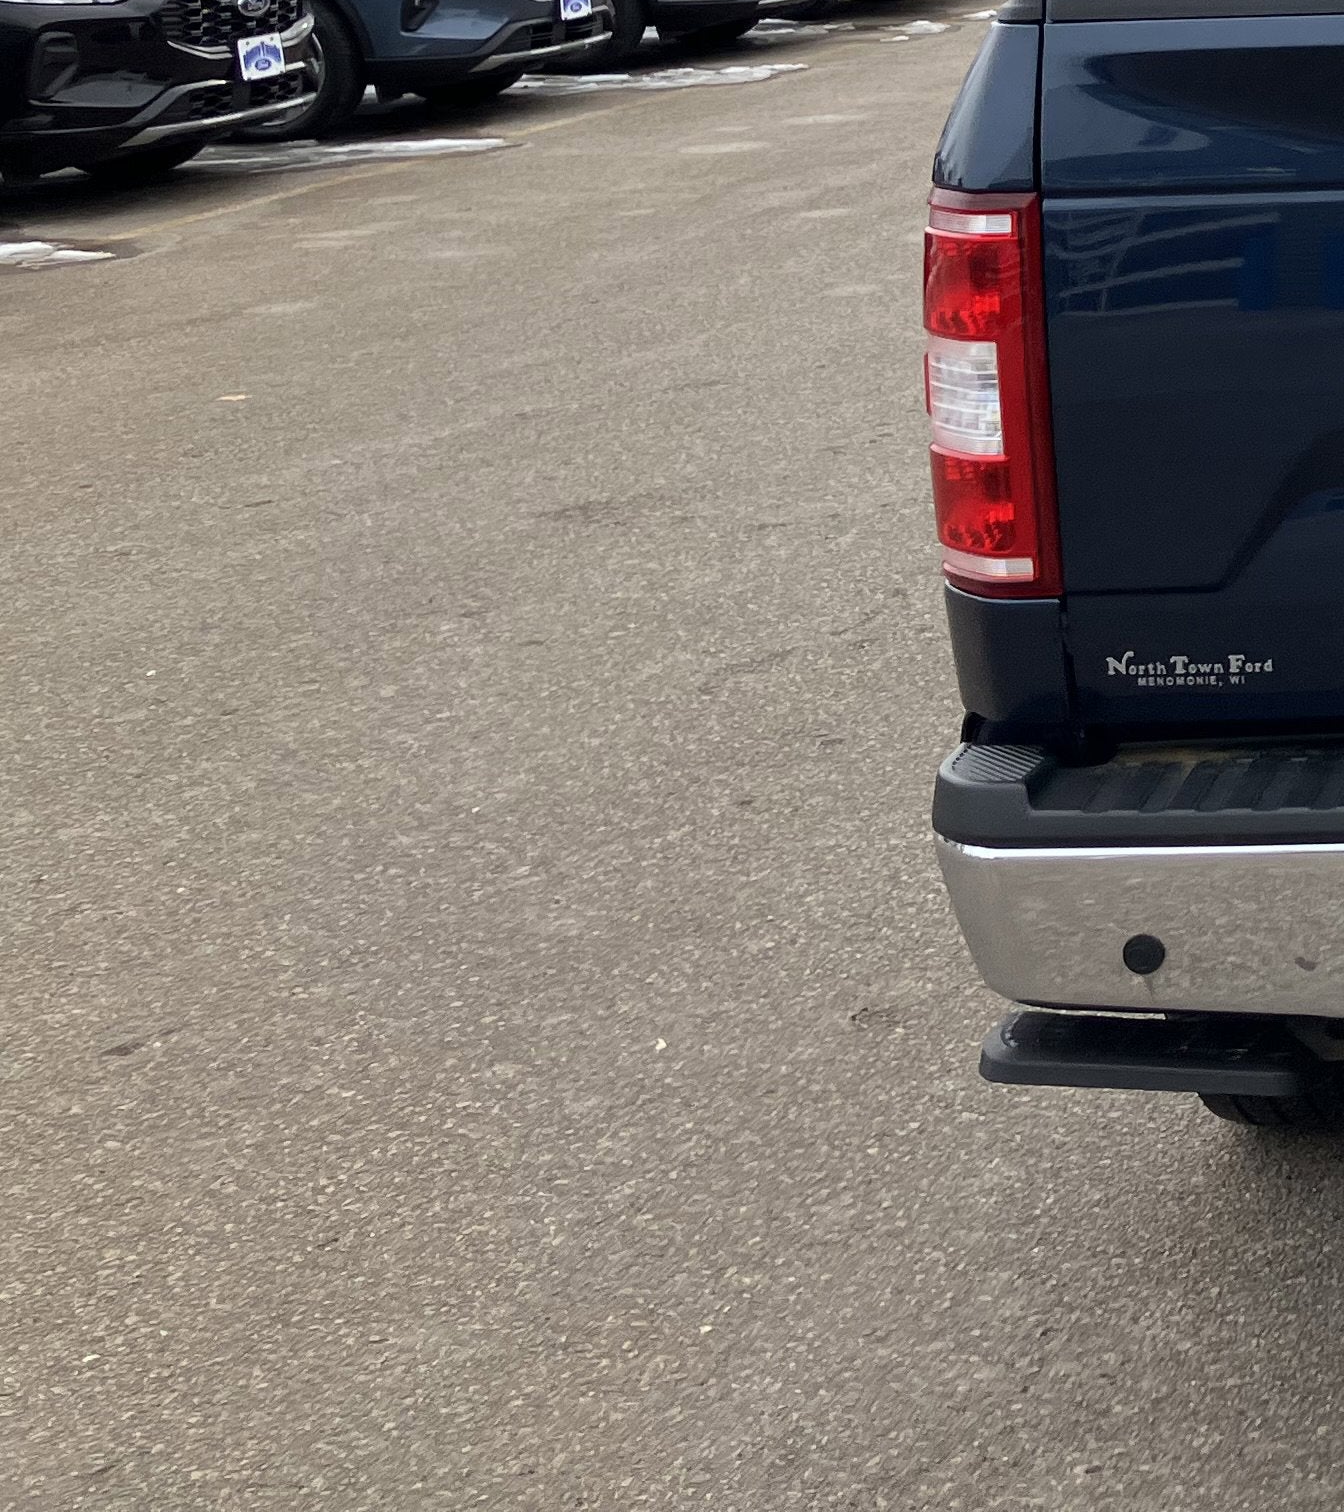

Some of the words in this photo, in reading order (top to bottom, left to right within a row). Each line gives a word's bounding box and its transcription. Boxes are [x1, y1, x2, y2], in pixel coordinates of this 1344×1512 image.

[1105, 650, 1167, 675] North
[1170, 654, 1225, 675] Town
[1228, 653, 1273, 673] Ford
[1229, 675, 1246, 685] WI
